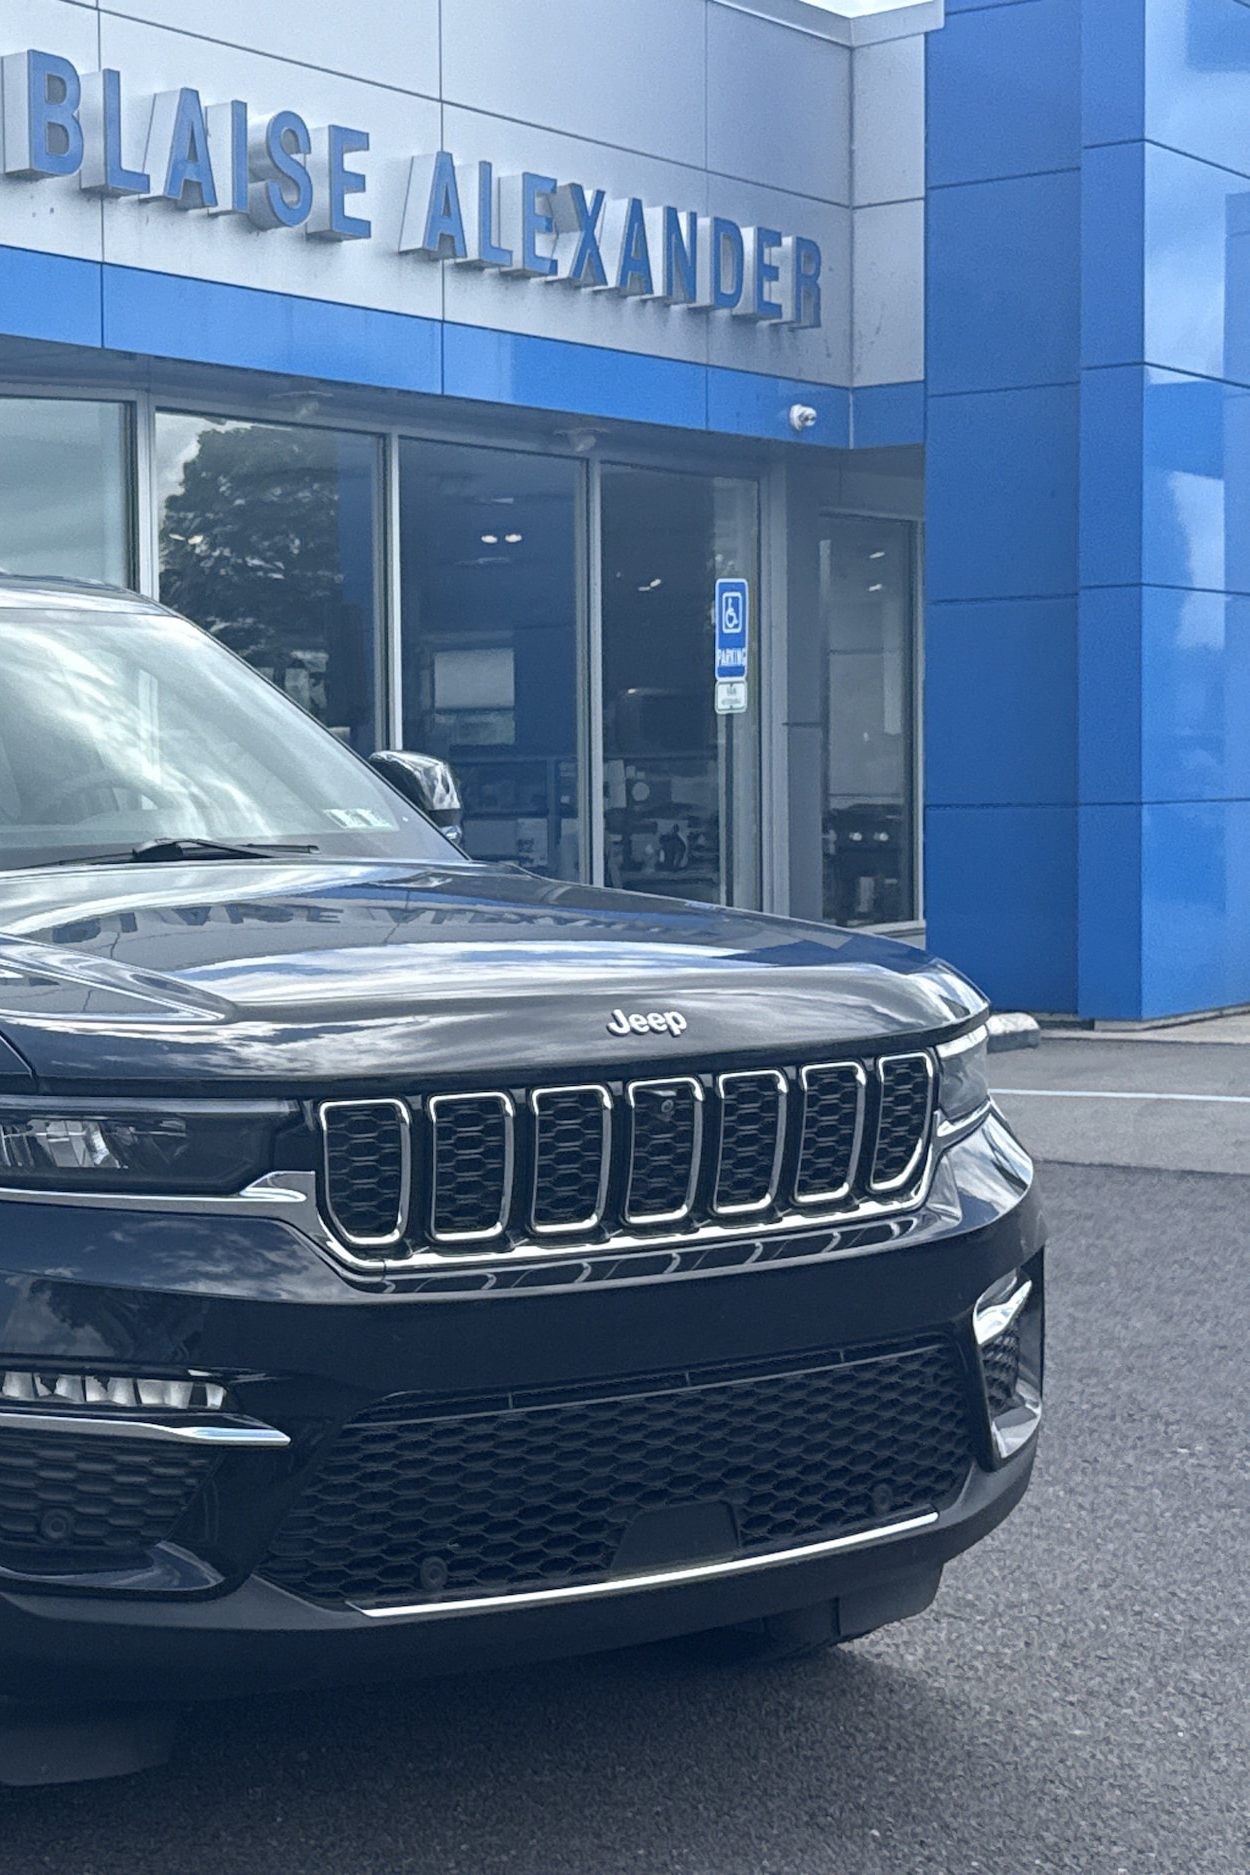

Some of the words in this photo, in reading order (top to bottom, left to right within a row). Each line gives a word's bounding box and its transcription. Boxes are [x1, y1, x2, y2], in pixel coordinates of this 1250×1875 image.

[26, 48, 372, 240] BLAISE
[427, 150, 823, 330] ALEXANDER
[717, 648, 746, 667] PARKING
[607, 1008, 688, 1037] Jeep
